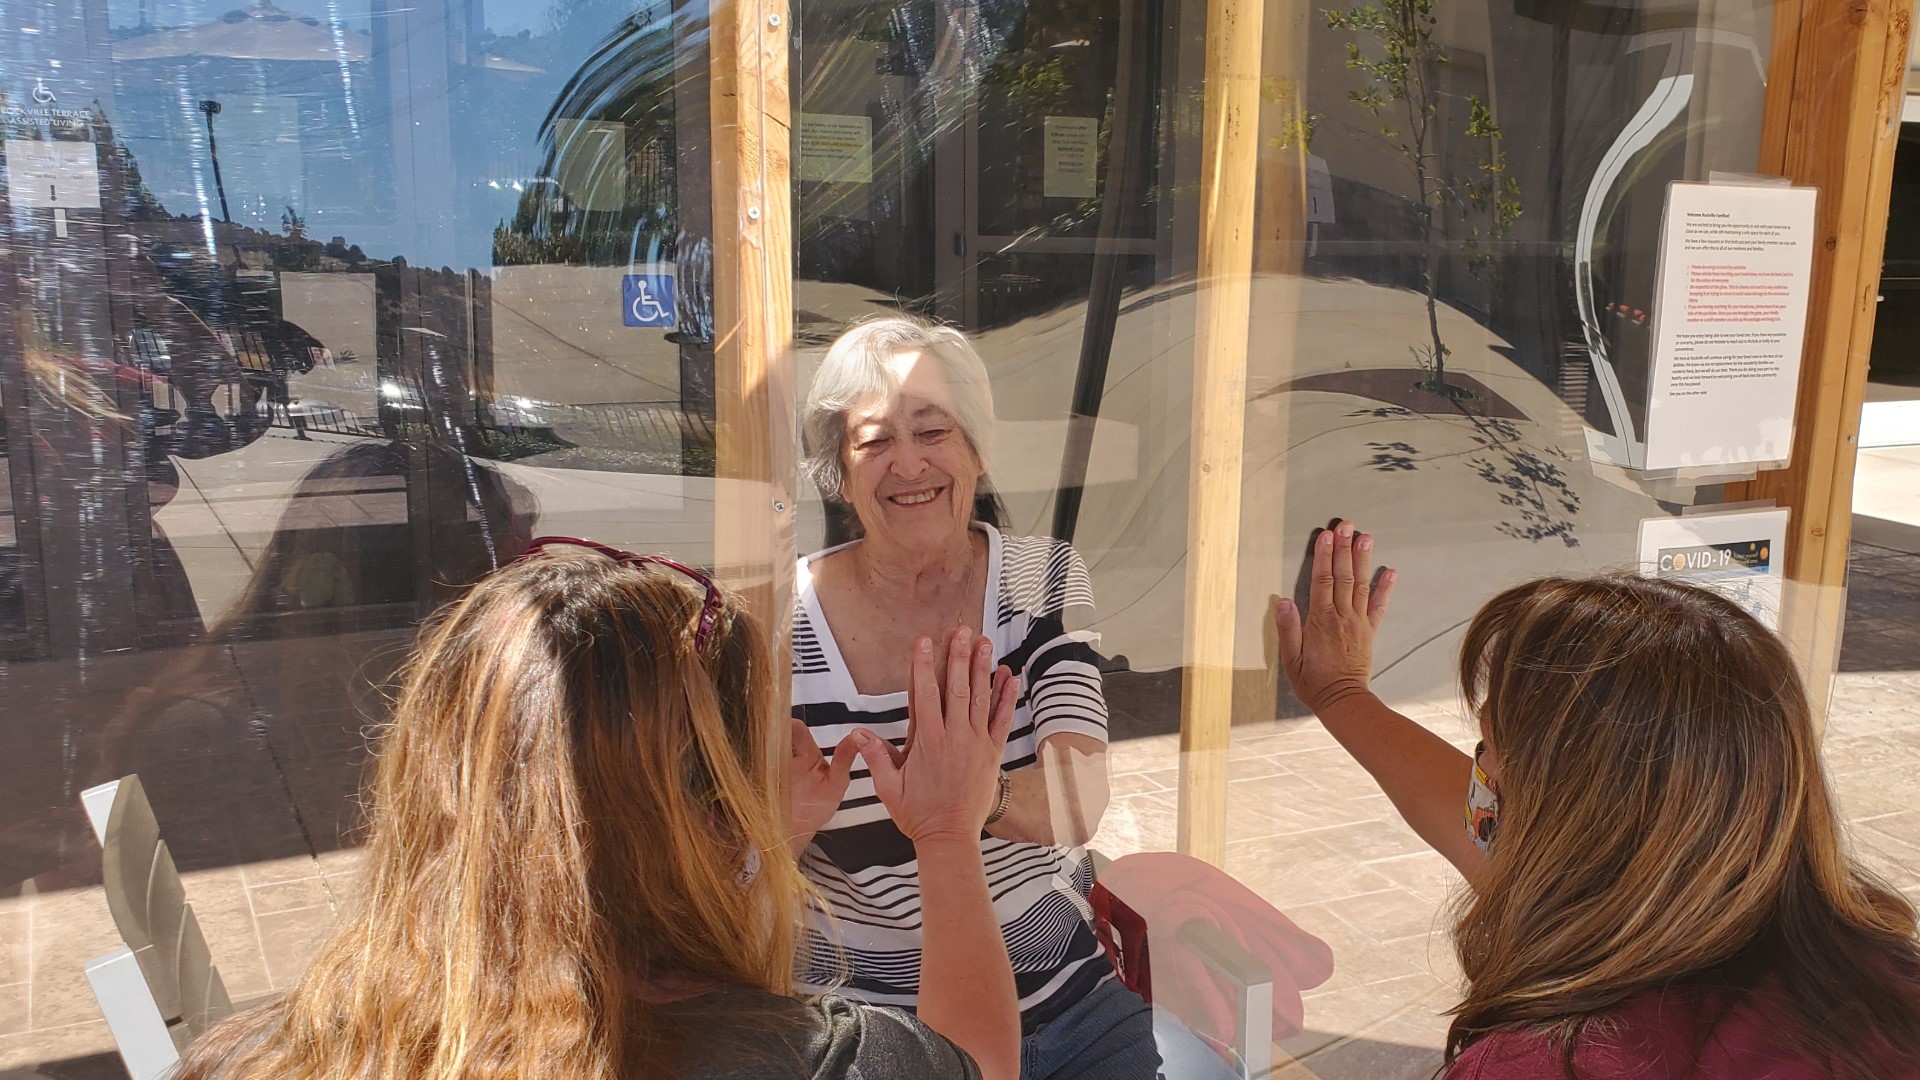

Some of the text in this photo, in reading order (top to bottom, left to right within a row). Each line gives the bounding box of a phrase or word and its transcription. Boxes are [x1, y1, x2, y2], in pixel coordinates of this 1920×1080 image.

[1, 107, 90, 118] ROCKVILLE TERRACE
[9, 117, 83, 127] ASSISTED LIVING
[1660, 548, 1731, 571] COVID-19
